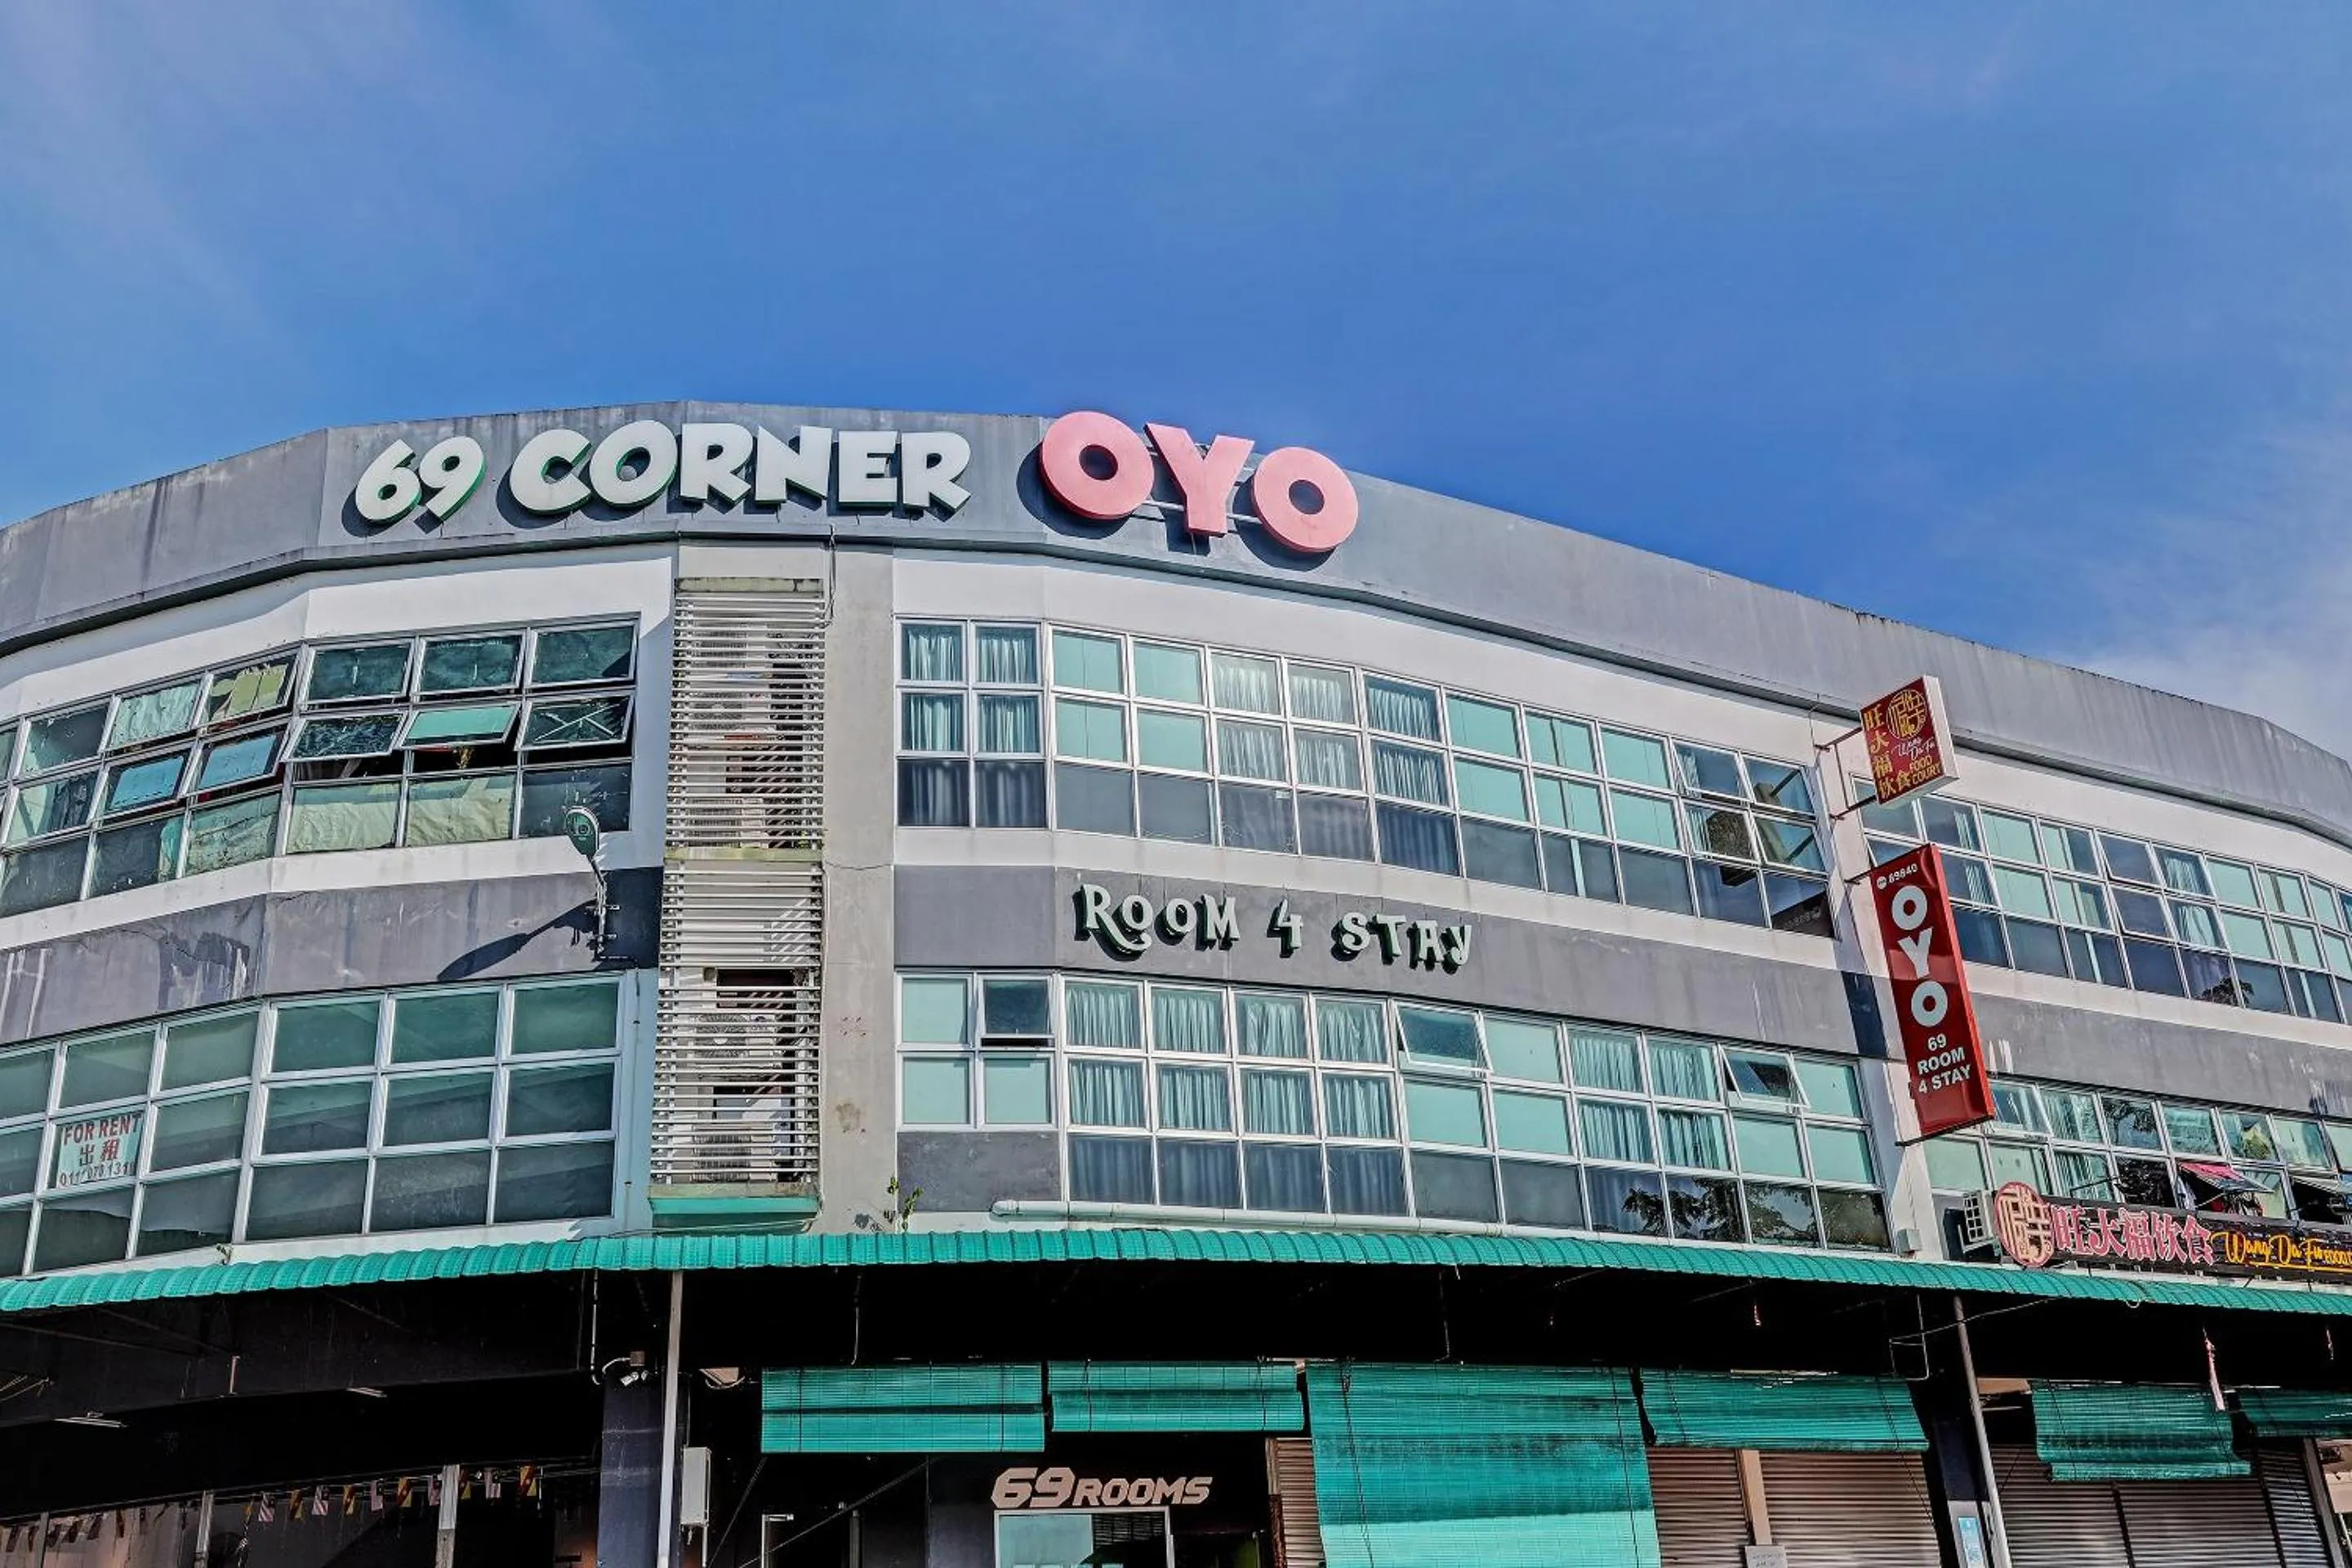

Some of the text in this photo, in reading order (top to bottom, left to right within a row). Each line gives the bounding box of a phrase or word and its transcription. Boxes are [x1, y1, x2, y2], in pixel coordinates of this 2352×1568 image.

[355, 420, 972, 524] 69 CORNER
[1040, 411, 1358, 552] OYO
[1909, 755, 1932, 774] FOOD
[1913, 761, 1941, 785] COURT
[1082, 884, 1472, 966] ROOM 4 STAY
[1891, 885, 1948, 1027] OYO
[1928, 1033, 1946, 1051] 69
[1918, 1047, 1965, 1075] ROOM
[1918, 1064, 1971, 1093] 4 STAY
[64, 1113, 141, 1145] FOR RENT
[2211, 1232, 2270, 1263] Wang
[2269, 1235, 2301, 1264] Da
